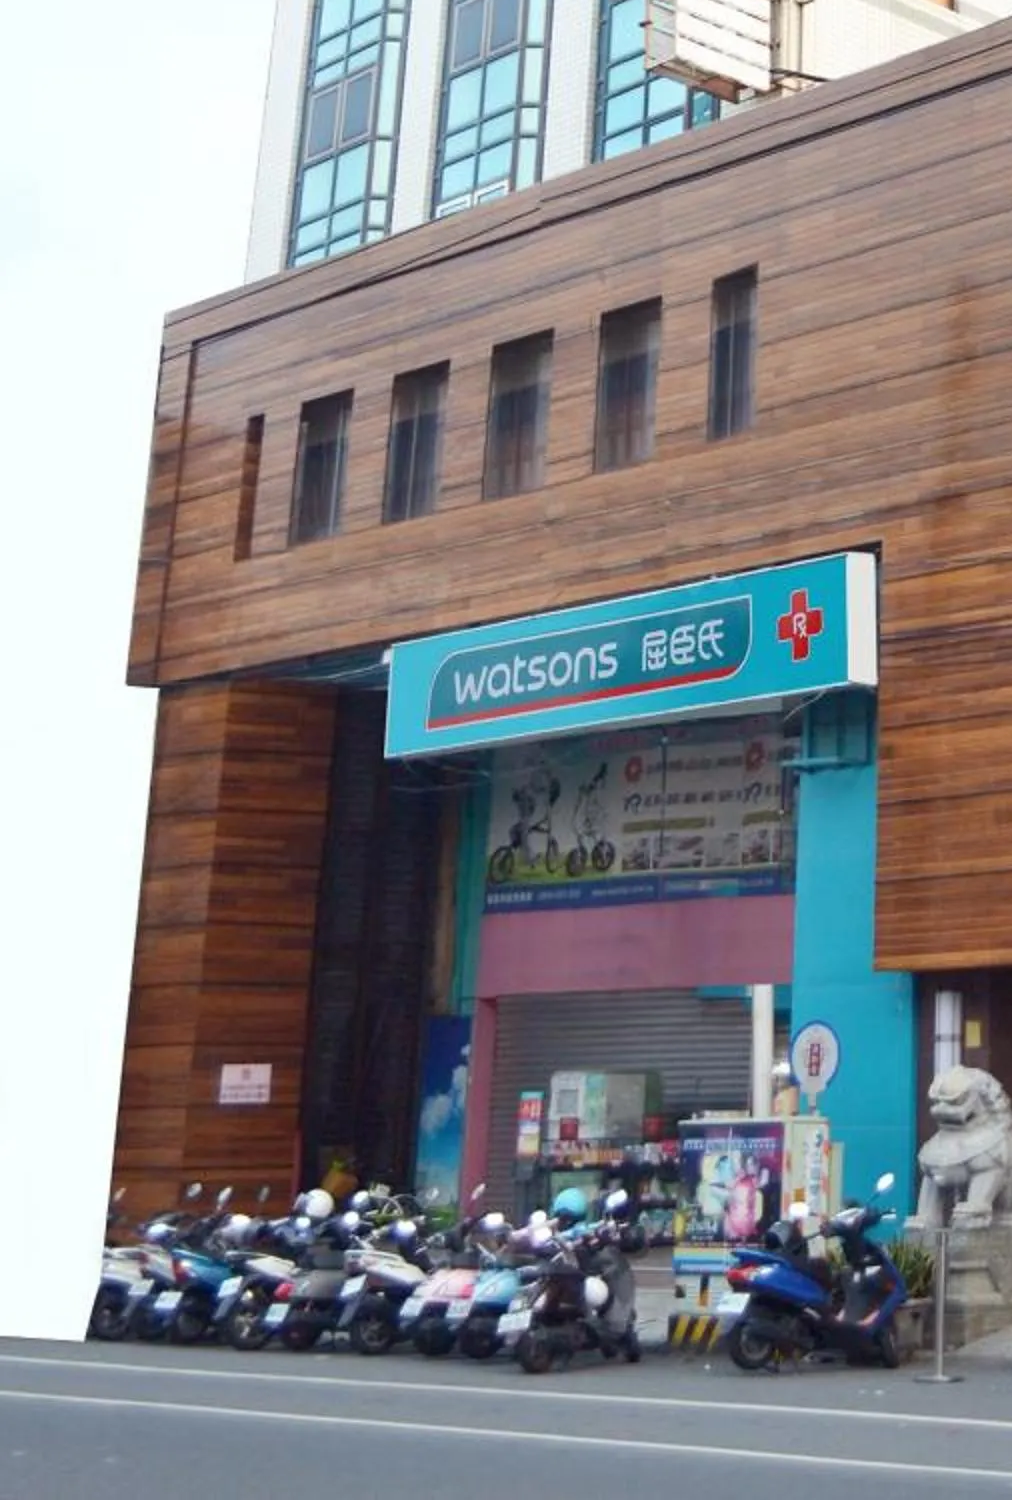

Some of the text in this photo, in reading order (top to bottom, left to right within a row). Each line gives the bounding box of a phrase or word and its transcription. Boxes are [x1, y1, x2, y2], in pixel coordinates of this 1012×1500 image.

[453, 642, 618, 706] watsons
[642, 619, 725, 672] 屈臣氏
